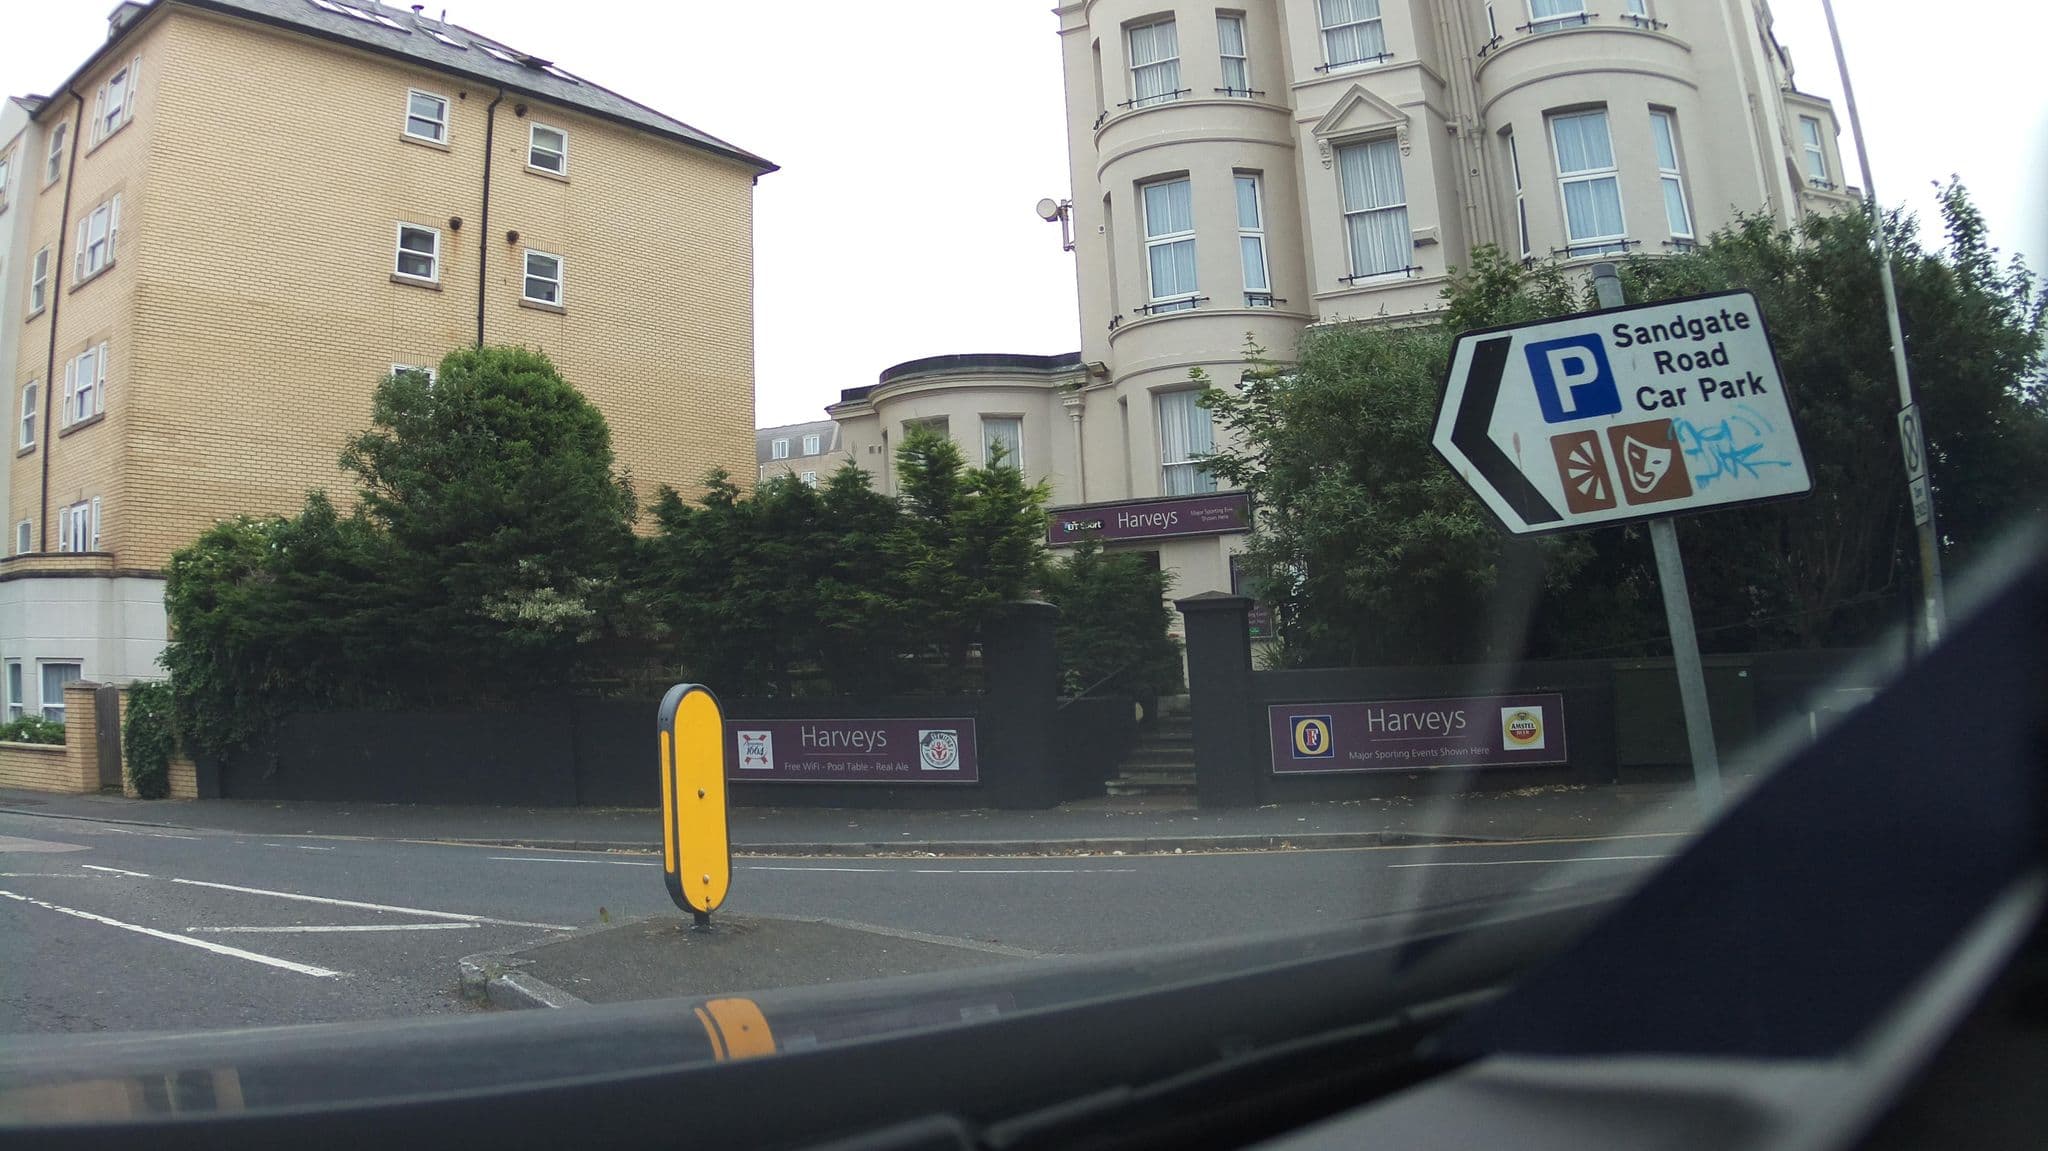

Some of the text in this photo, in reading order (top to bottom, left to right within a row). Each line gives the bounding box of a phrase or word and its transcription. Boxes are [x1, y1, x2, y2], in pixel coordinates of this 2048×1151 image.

[1612, 309, 1750, 348] Sandgate
[1653, 341, 1729, 375] Road
[1546, 345, 1599, 413] P
[1636, 371, 1767, 411] Car Park
[1118, 510, 1178, 529] Harveys
[1367, 708, 1466, 736] Harveys
[801, 725, 887, 752] Harveys
[784, 762, 800, 772] Free
[827, 762, 845, 772] Pool
[847, 762, 869, 772] Table
[876, 762, 893, 772] Real
[895, 762, 909, 772] Ale
[1349, 746, 1490, 761] Major Sporting Events Shown Here
